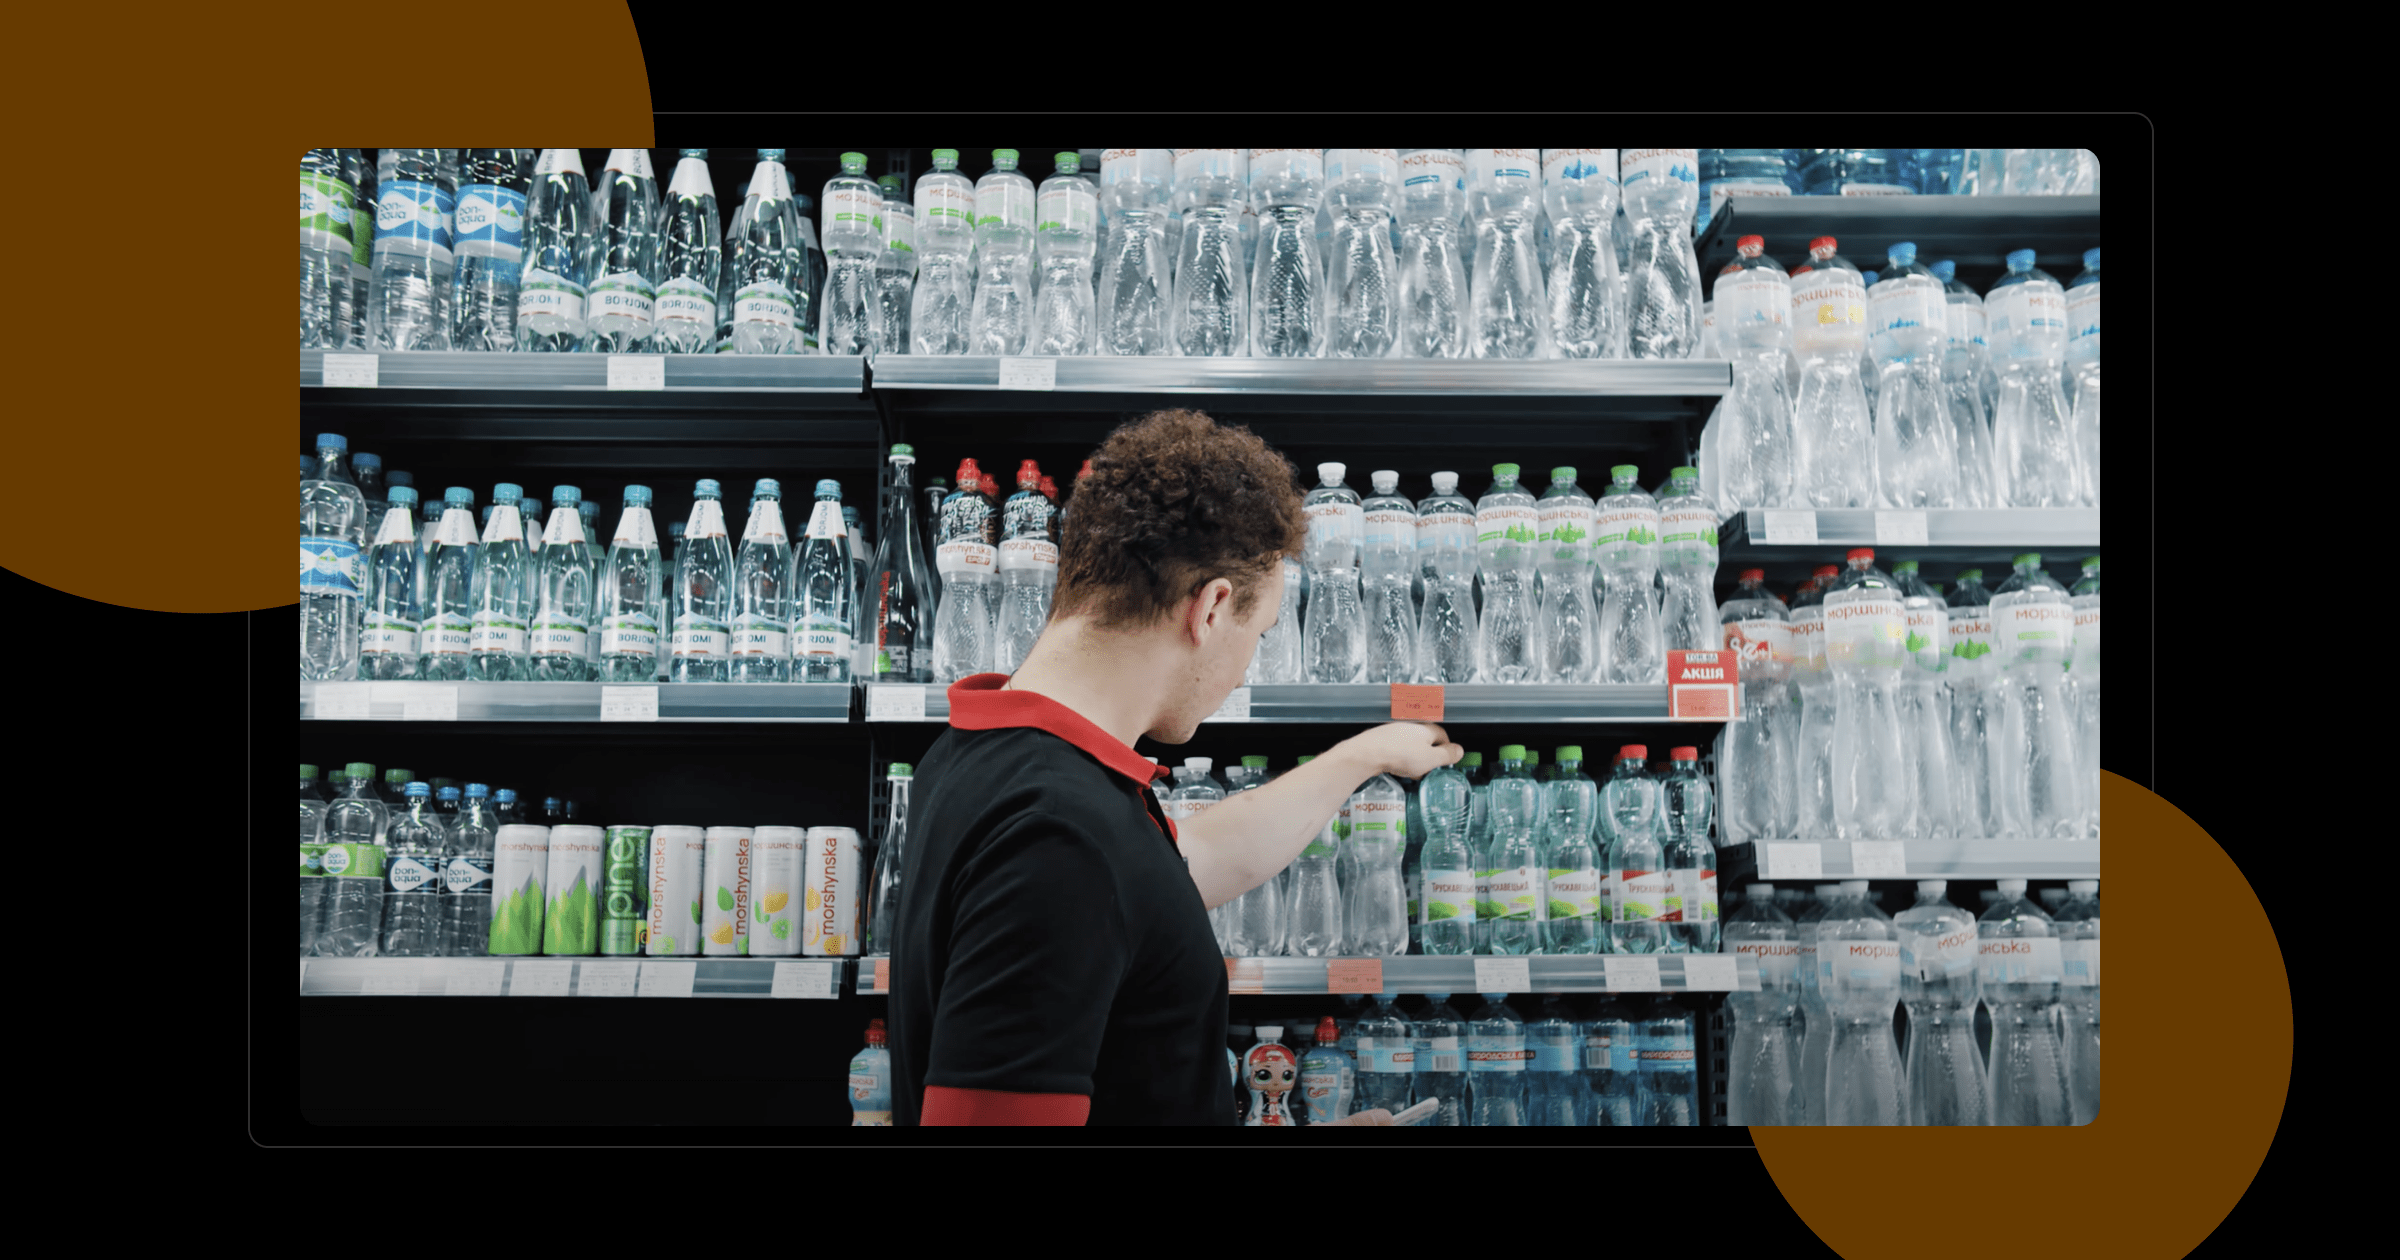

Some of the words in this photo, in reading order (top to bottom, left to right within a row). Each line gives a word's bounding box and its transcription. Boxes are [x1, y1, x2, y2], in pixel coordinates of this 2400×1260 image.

[662, 299, 705, 312] BORJOMI
[818, 503, 828, 536] BORJOMI
[1681, 668, 1724, 680] АКЦІЯ
[394, 874, 421, 884] aqua
[605, 837, 640, 919] pine
[652, 837, 668, 935] morshynska
[734, 838, 750, 936] morshynska
[821, 837, 837, 936] morshynska
